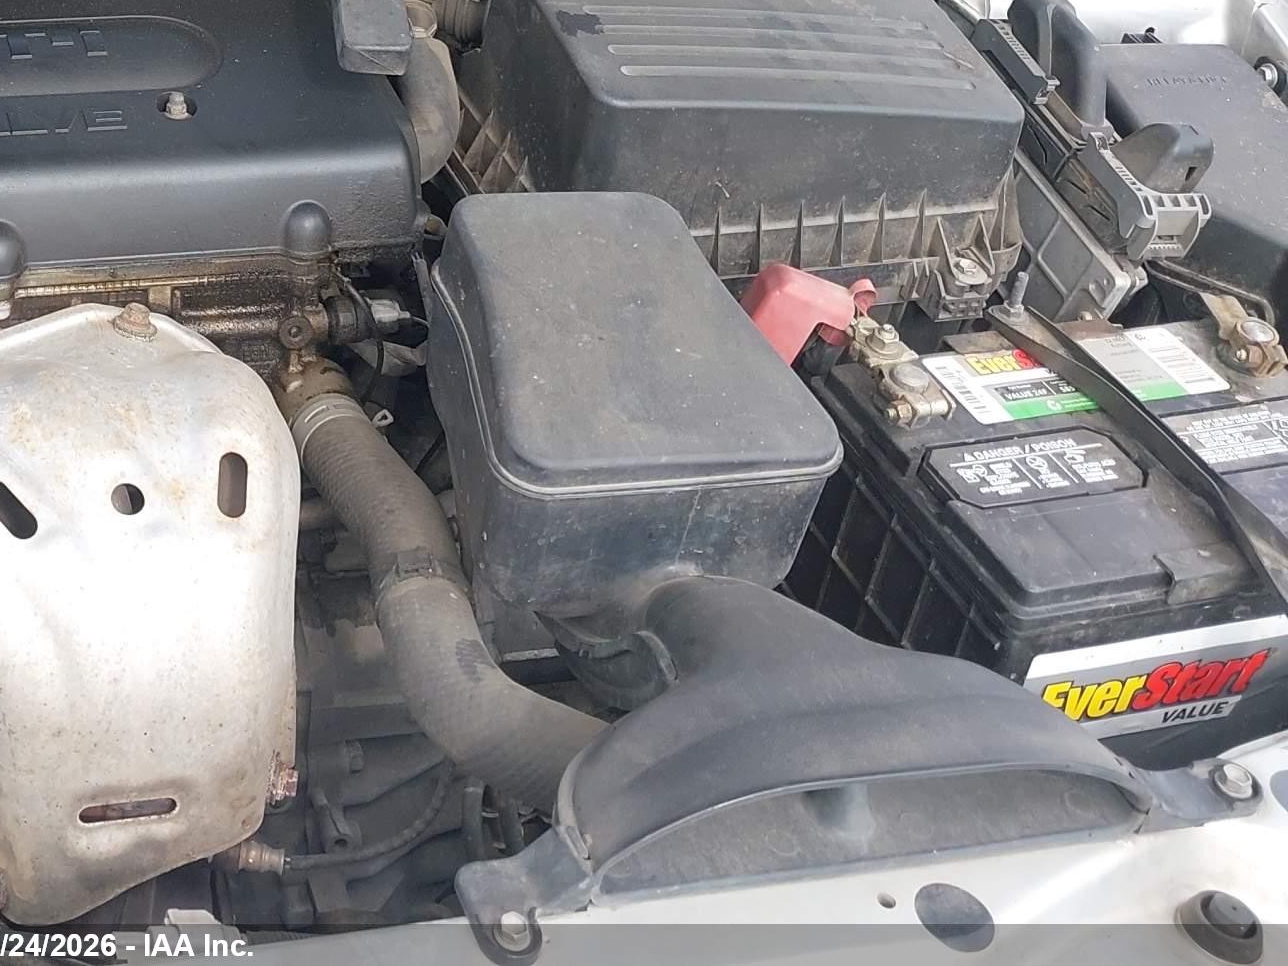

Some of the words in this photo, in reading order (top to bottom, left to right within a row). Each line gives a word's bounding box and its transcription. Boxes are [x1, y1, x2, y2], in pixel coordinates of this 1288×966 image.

[973, 445, 1024, 462] DANGER
[1031, 438, 1077, 453] POISON
[1042, 647, 1272, 721] EverStart
[1161, 701, 1229, 724] VALUE
